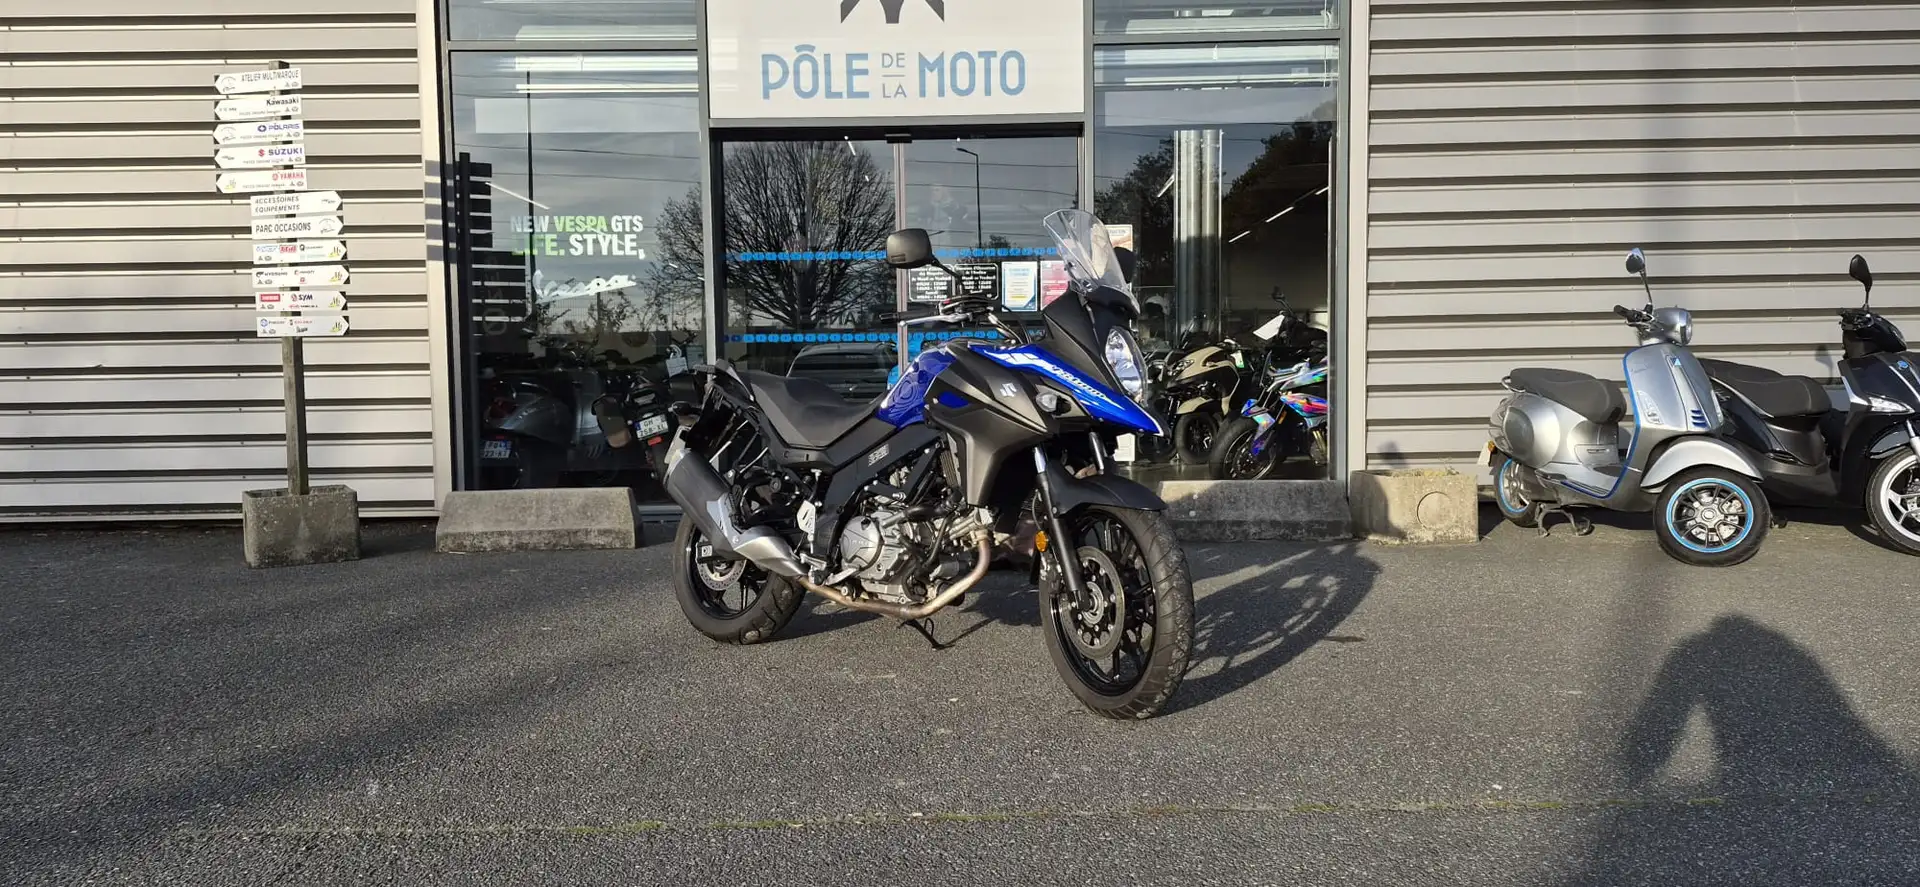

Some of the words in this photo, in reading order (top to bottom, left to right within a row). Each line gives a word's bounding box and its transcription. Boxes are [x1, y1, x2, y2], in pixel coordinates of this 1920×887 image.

[241, 73, 261, 82] ATELIER
[262, 69, 299, 81] MULTIMARQUE
[762, 44, 870, 100] PÔLE
[881, 52, 906, 69] DE
[918, 50, 1025, 98] MOTO
[882, 83, 908, 99] LA
[266, 96, 300, 106] Kawasaki
[268, 123, 300, 131] POLARIS
[268, 147, 303, 156] SUZUKI
[280, 172, 304, 180] YAMAHA
[255, 224, 272, 233] PARC
[274, 221, 311, 233] OCCASIONS
[510, 215, 550, 232] NEW
[553, 215, 608, 232] VESPA
[611, 215, 644, 232] GTS
[511, 234, 566, 256] LIFE.
[298, 293, 313, 301] SYM
